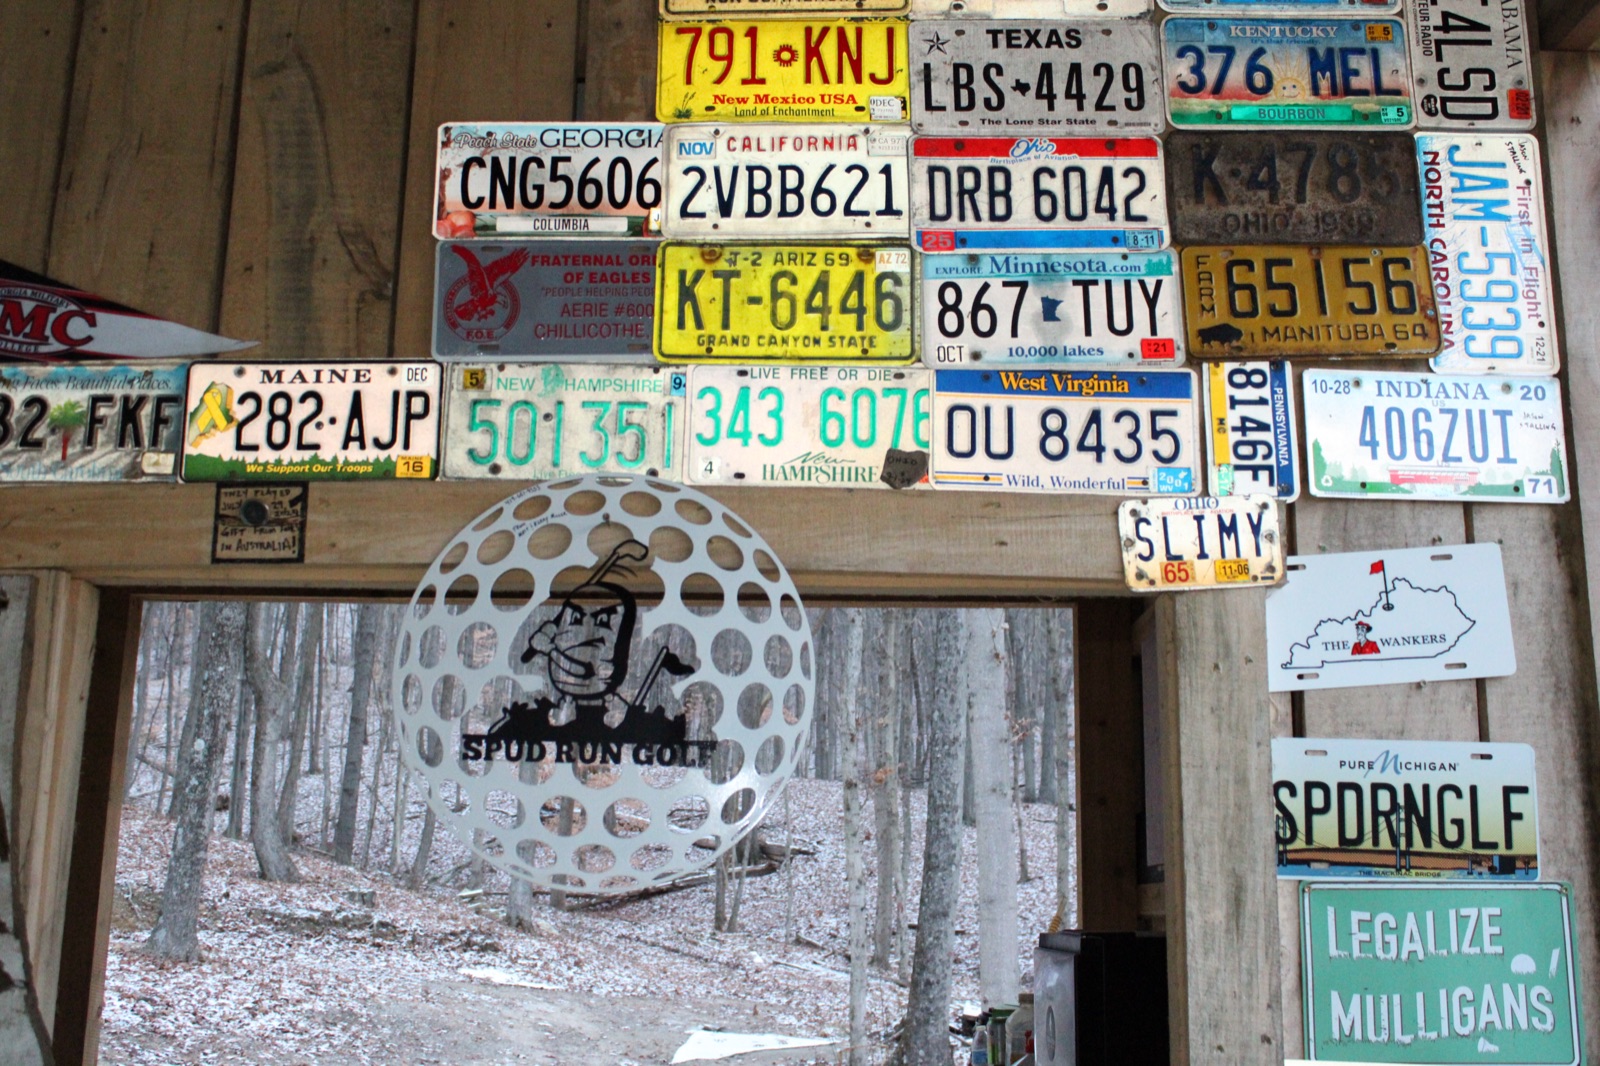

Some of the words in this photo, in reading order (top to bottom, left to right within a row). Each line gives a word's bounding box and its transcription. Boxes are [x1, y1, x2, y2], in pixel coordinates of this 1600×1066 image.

[986, 28, 1082, 49] TEXAS
[1229, 25, 1338, 38] KENTUCKY
[1383, 26, 1390, 36] 5
[1420, 25, 1433, 57] RADIO
[676, 26, 766, 85] 791
[804, 26, 895, 85] KNJ
[1430, 0, 1499, 120] 4LSD
[1176, 45, 1274, 96] 376
[1308, 47, 1402, 97] MEL
[923, 62, 1005, 112] LBS
[1035, 62, 1146, 112] 4429
[712, 94, 749, 105] New
[753, 94, 816, 105] Mexico
[819, 94, 858, 105] USA
[876, 98, 895, 107] DEC
[734, 106, 757, 117] Land
[759, 106, 770, 117] of
[772, 106, 835, 117] Enchantment
[1258, 107, 1326, 119] BOURBON
[1396, 107, 1404, 117] 5
[979, 118, 1002, 126] The
[1005, 118, 1034, 126] Lone
[1037, 118, 1063, 126] Star
[1065, 118, 1097, 126] State
[453, 132, 497, 148] Peach
[500, 132, 537, 148] State
[727, 135, 858, 152] CALIFORNIA
[1010, 138, 1055, 158] Ohio
[679, 142, 714, 156] NOV
[990, 156, 1031, 165] Birthplace
[460, 156, 661, 210] CNG5606
[679, 163, 903, 219] 2VBB621
[1423, 151, 1445, 229] NORTH
[927, 165, 1012, 222] DRB
[1033, 165, 1148, 222] 6042
[1516, 185, 1533, 227] First
[533, 218, 589, 231] COLUMBIA
[1223, 213, 1290, 233] OHIO
[923, 233, 953, 247] 25
[1521, 236, 1535, 255] in
[773, 251, 816, 267] ARIZ
[824, 251, 850, 267] 69
[879, 253, 891, 265] AZ
[895, 253, 908, 265] 72
[1448, 144, 1523, 359] JAM-5939
[530, 254, 624, 267] FRATERNAL
[935, 267, 983, 275] EXPLORE
[989, 256, 1141, 275] Minnesota.com
[563, 272, 586, 284] OF
[589, 272, 650, 284] EAGLES
[30, 290, 70, 308] MILITARY
[585, 286, 629, 297] HELPING
[1429, 238, 1455, 350] CAROLINA
[1522, 266, 1541, 319] Flight
[677, 269, 903, 332] KT-6446
[937, 280, 1029, 339] 867
[1072, 279, 1163, 337] TUY
[561, 303, 609, 317] AERIE
[1394, 322, 1429, 341] 64
[697, 335, 750, 348] GRAND
[757, 335, 821, 348] CANYON
[828, 335, 877, 349] STATE
[1153, 342, 1167, 352] 21
[1535, 336, 1546, 362] 12-21
[937, 345, 964, 363] OCT
[1008, 346, 1058, 359] 10,000
[1063, 345, 1104, 357] lakes
[65, 375, 129, 391] Beautiful
[259, 369, 371, 384] MAINE
[407, 368, 428, 382] DEC
[469, 372, 479, 386] 5
[750, 368, 780, 380] LIVE
[790, 368, 828, 380] FREE
[837, 368, 858, 381] OR
[868, 369, 892, 381] DIE
[496, 377, 535, 391] NEW
[564, 378, 663, 393] HAMPSHIRE
[999, 371, 1048, 392] West
[1051, 373, 1129, 396] Virginia
[1311, 379, 1351, 395] 10-28
[1375, 380, 1490, 400] INDIANA
[1519, 385, 1546, 401] 20
[1431, 400, 1446, 408] US
[86, 394, 180, 448] FKF
[695, 386, 784, 447] 343
[819, 387, 930, 449] 6076
[946, 404, 1014, 460] OU
[1039, 407, 1181, 465] 8435
[1228, 368, 1275, 487] 8146F
[1274, 387, 1289, 467] PENNSYLVANIA
[403, 461, 423, 472] 16
[783, 451, 856, 465] New
[246, 464, 264, 473] We
[266, 464, 309, 475] Support
[312, 464, 333, 473] Our
[336, 464, 373, 475] Troops
[704, 461, 714, 475] 4
[762, 463, 878, 483] HAMPSHIRE
[1006, 474, 1044, 490] Wild,
[1050, 475, 1126, 490] Wonderful
[1159, 472, 1189, 491] 2001
[1528, 478, 1553, 494] 71
[1174, 497, 1219, 511] OHIO
[1135, 513, 1264, 562] SLIMY
[1163, 562, 1190, 583] 65
[1222, 563, 1249, 576] 11-06
[1322, 640, 1350, 651] THE
[1379, 634, 1447, 647] WANKERS
[462, 737, 547, 763] SPUD
[555, 741, 625, 765] RUN
[632, 741, 717, 767] GOLF
[1339, 760, 1374, 770] PURE
[1273, 780, 1529, 850] SPDRNGLF
[1326, 906, 1504, 961] LEGALIZE
[1330, 983, 1555, 1044] MULLIGANS
